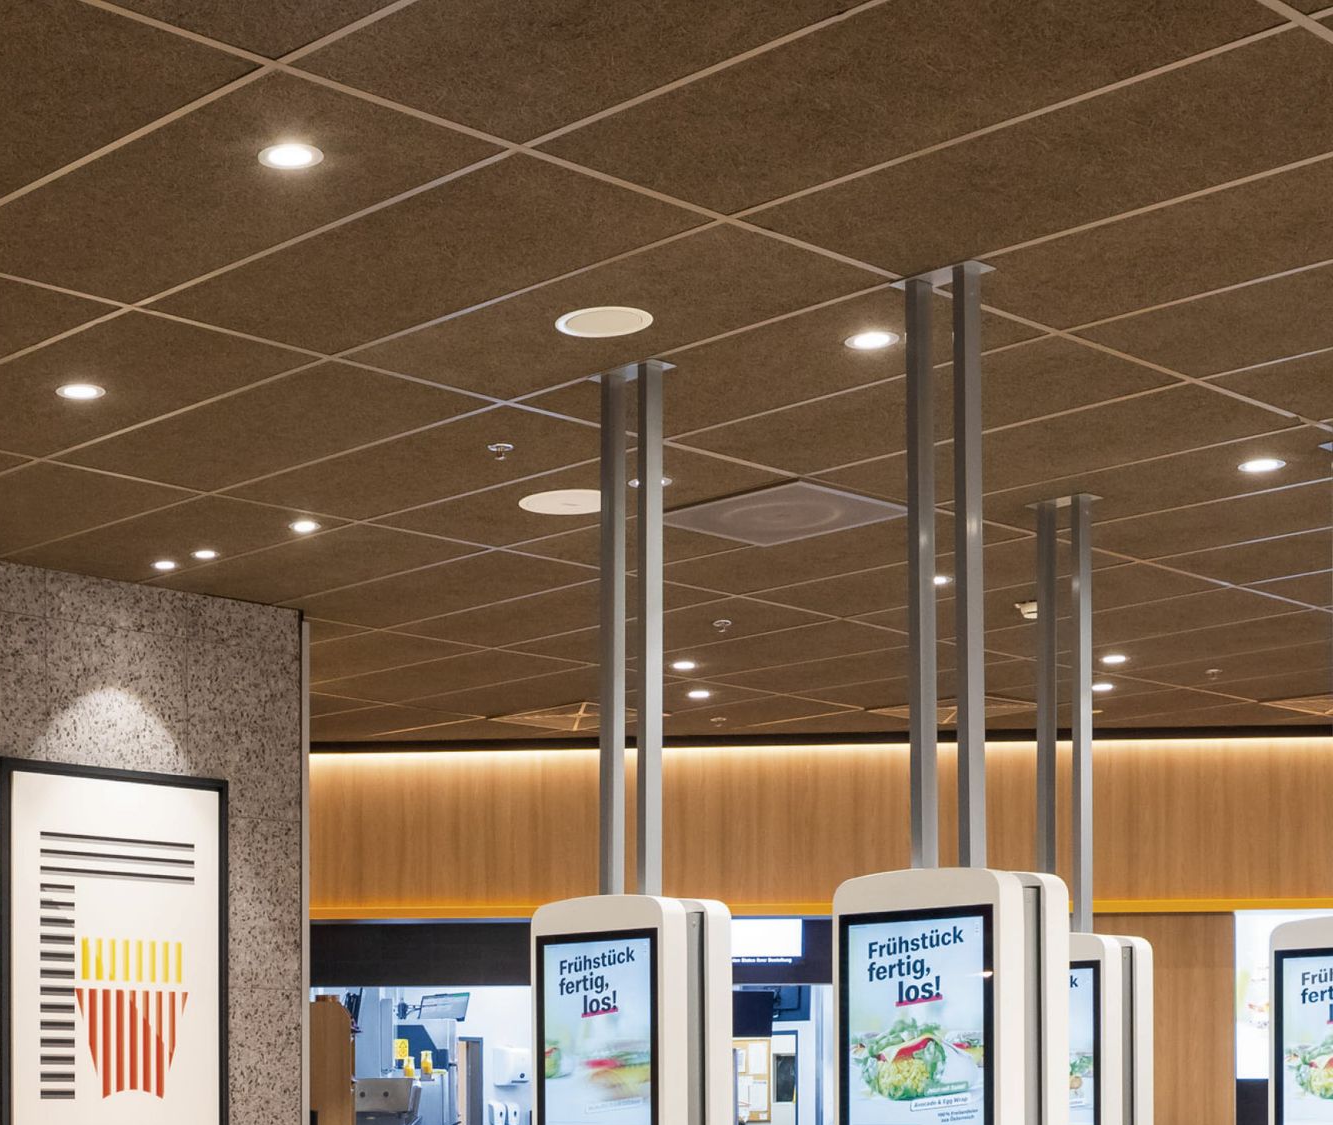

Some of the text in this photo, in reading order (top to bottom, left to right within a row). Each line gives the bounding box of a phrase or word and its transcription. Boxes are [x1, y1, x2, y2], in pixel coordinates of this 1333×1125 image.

[868, 926, 964, 959] Frühstück
[559, 946, 635, 976] Frühstück
[867, 954, 931, 982] fertig,
[559, 972, 609, 996] fertig,
[898, 976, 941, 1003] los!
[583, 990, 618, 1014] los!
